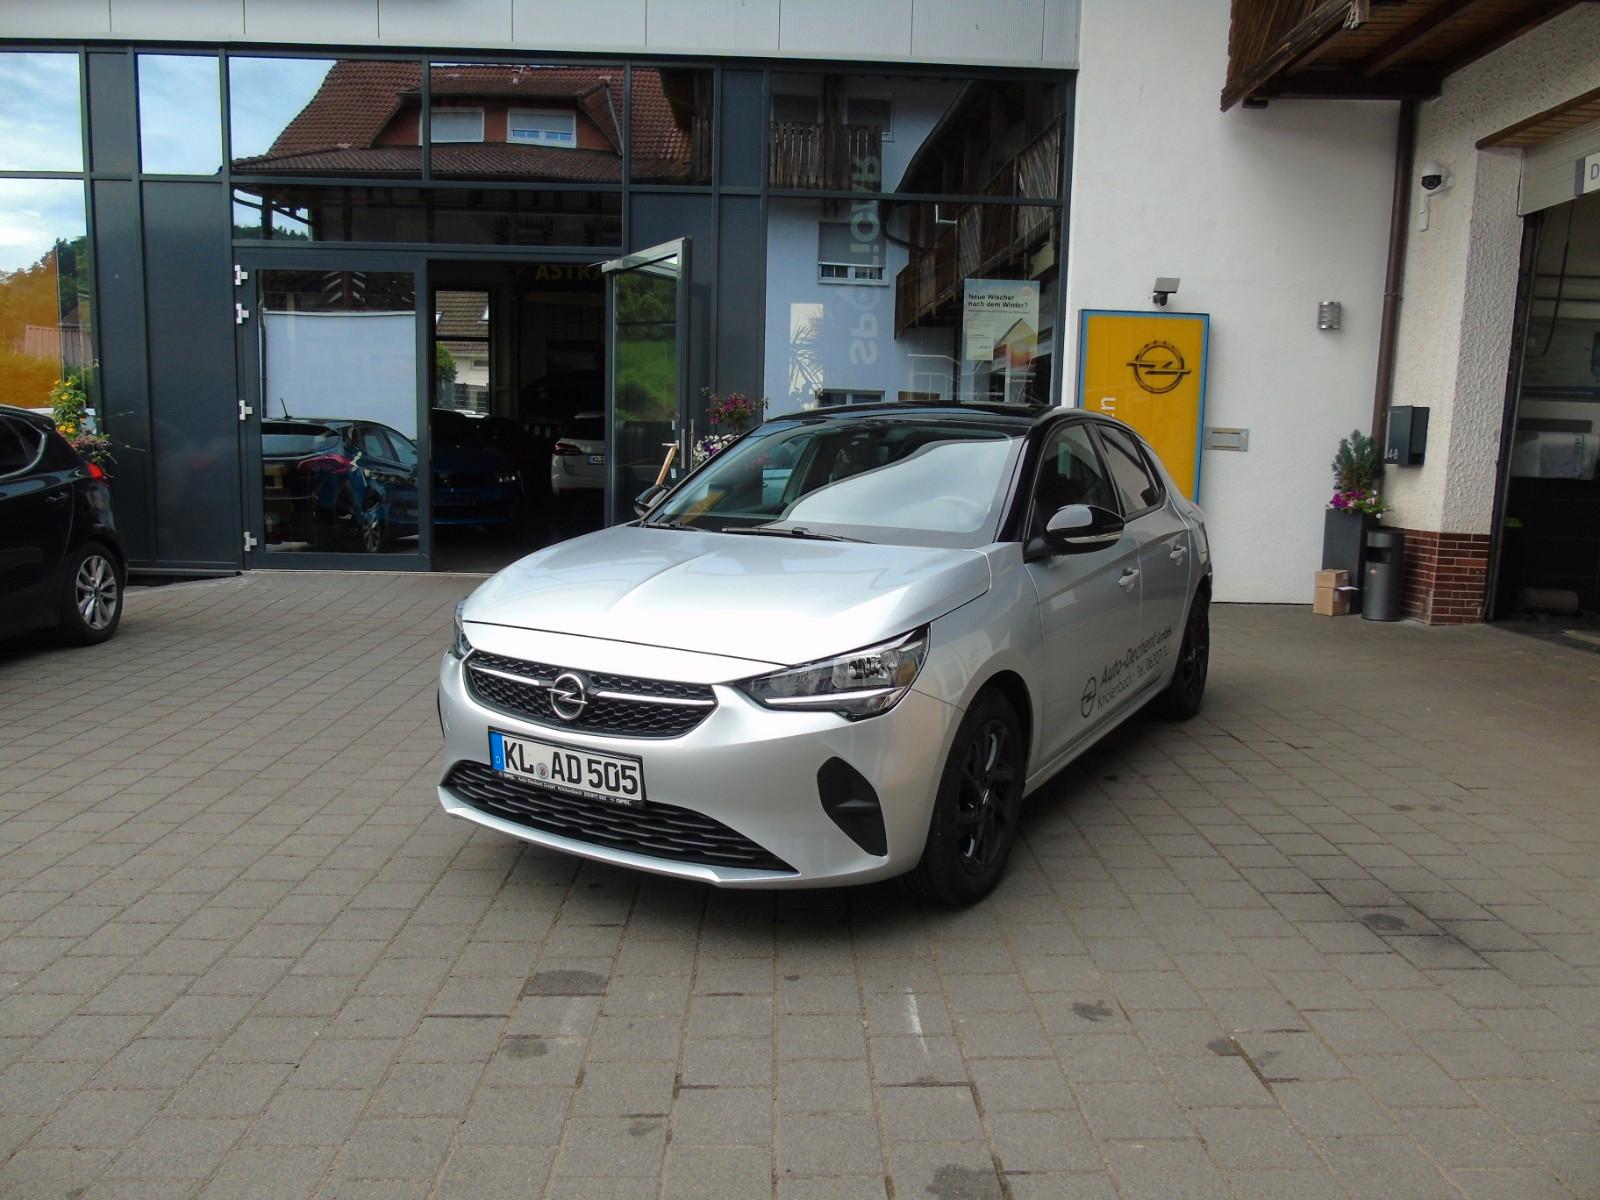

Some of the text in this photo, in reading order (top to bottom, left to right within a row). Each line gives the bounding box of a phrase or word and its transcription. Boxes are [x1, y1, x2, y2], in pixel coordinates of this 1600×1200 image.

[987, 293, 1015, 301] Wischer
[503, 740, 638, 795] KL AD 505
